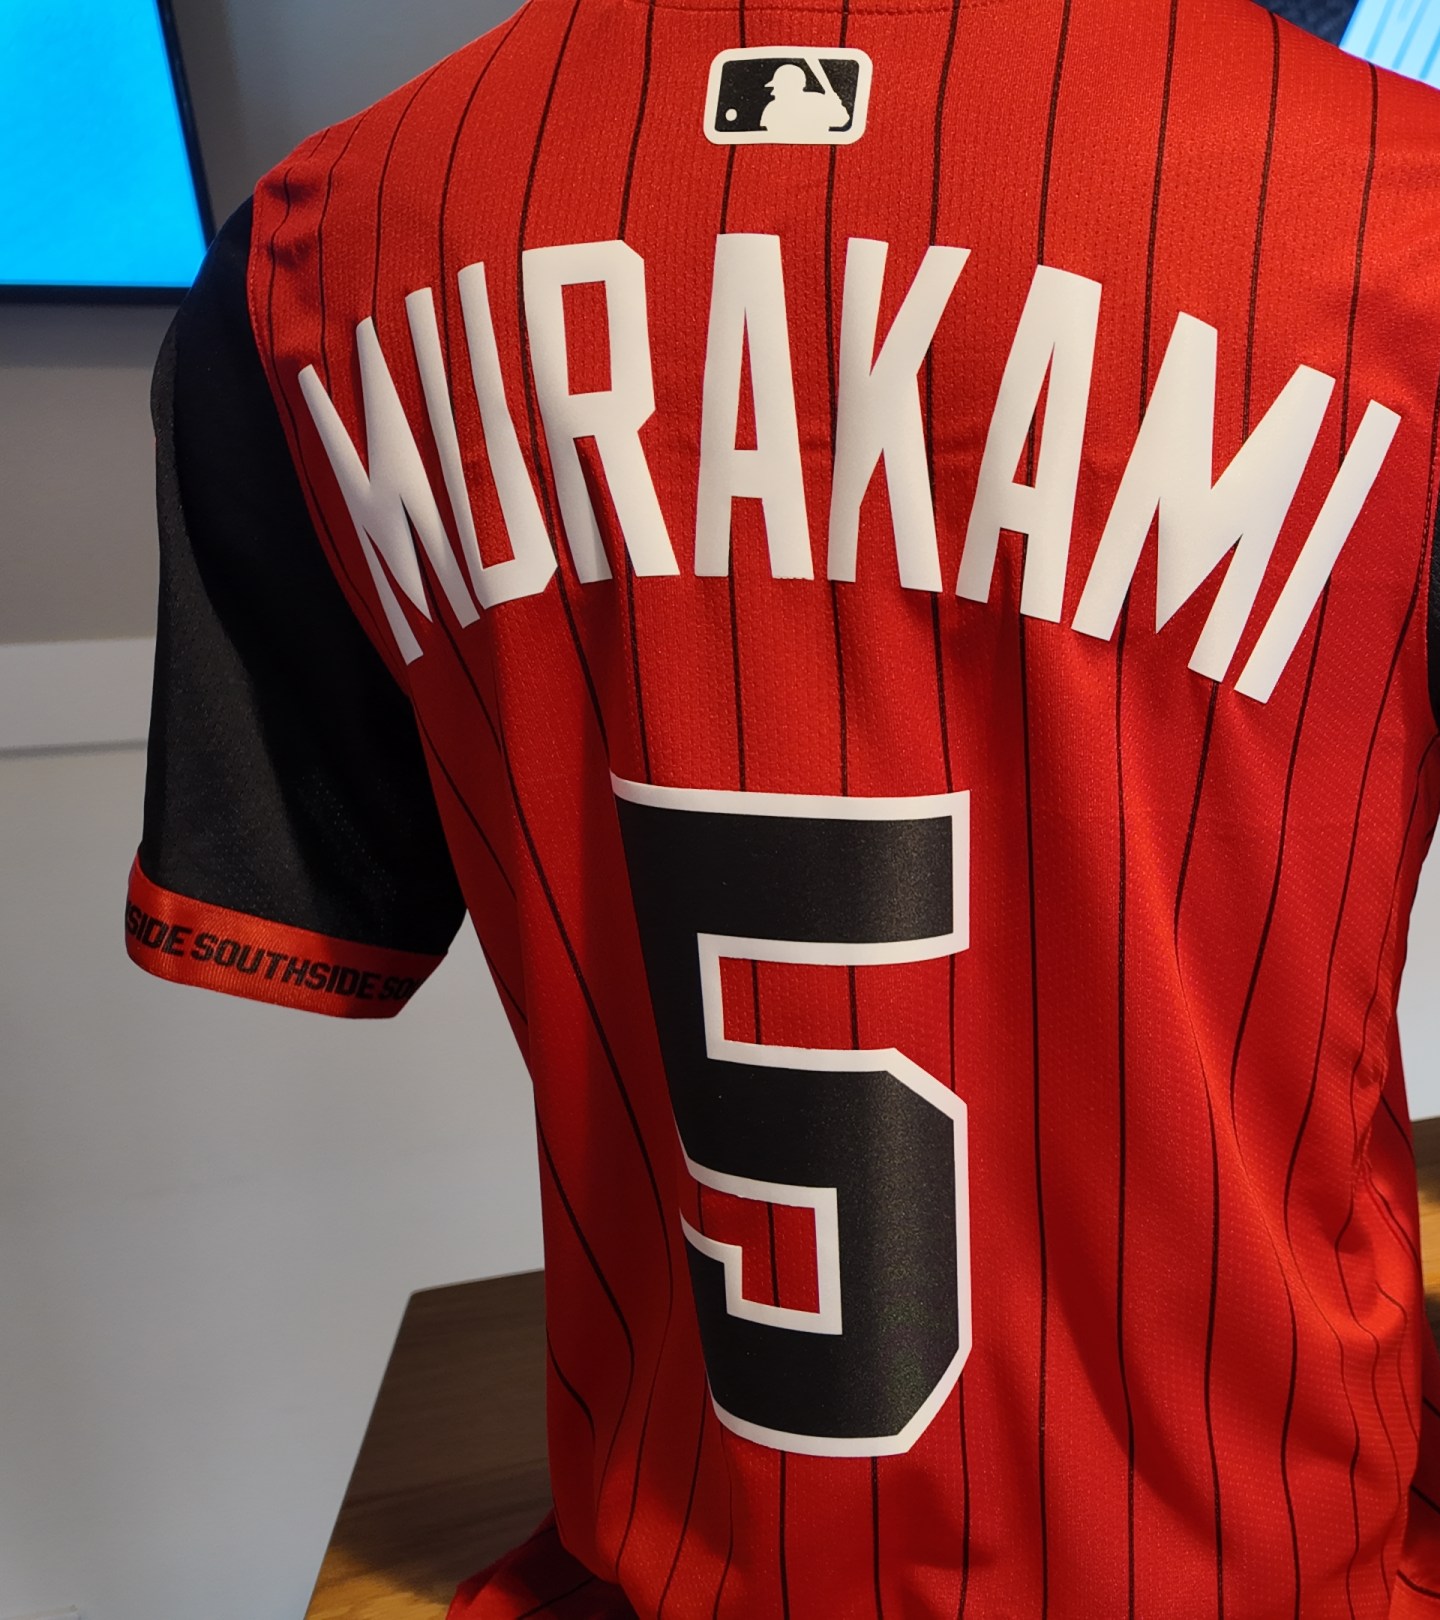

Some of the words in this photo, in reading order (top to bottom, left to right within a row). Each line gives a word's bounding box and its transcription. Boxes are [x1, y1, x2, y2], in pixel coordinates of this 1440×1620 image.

[297, 233, 1402, 704] MURAKAMI
[126, 903, 193, 957] SIDE
[191, 931, 382, 1000] SOUTHSIDE
[609, 770, 973, 1458] 5
